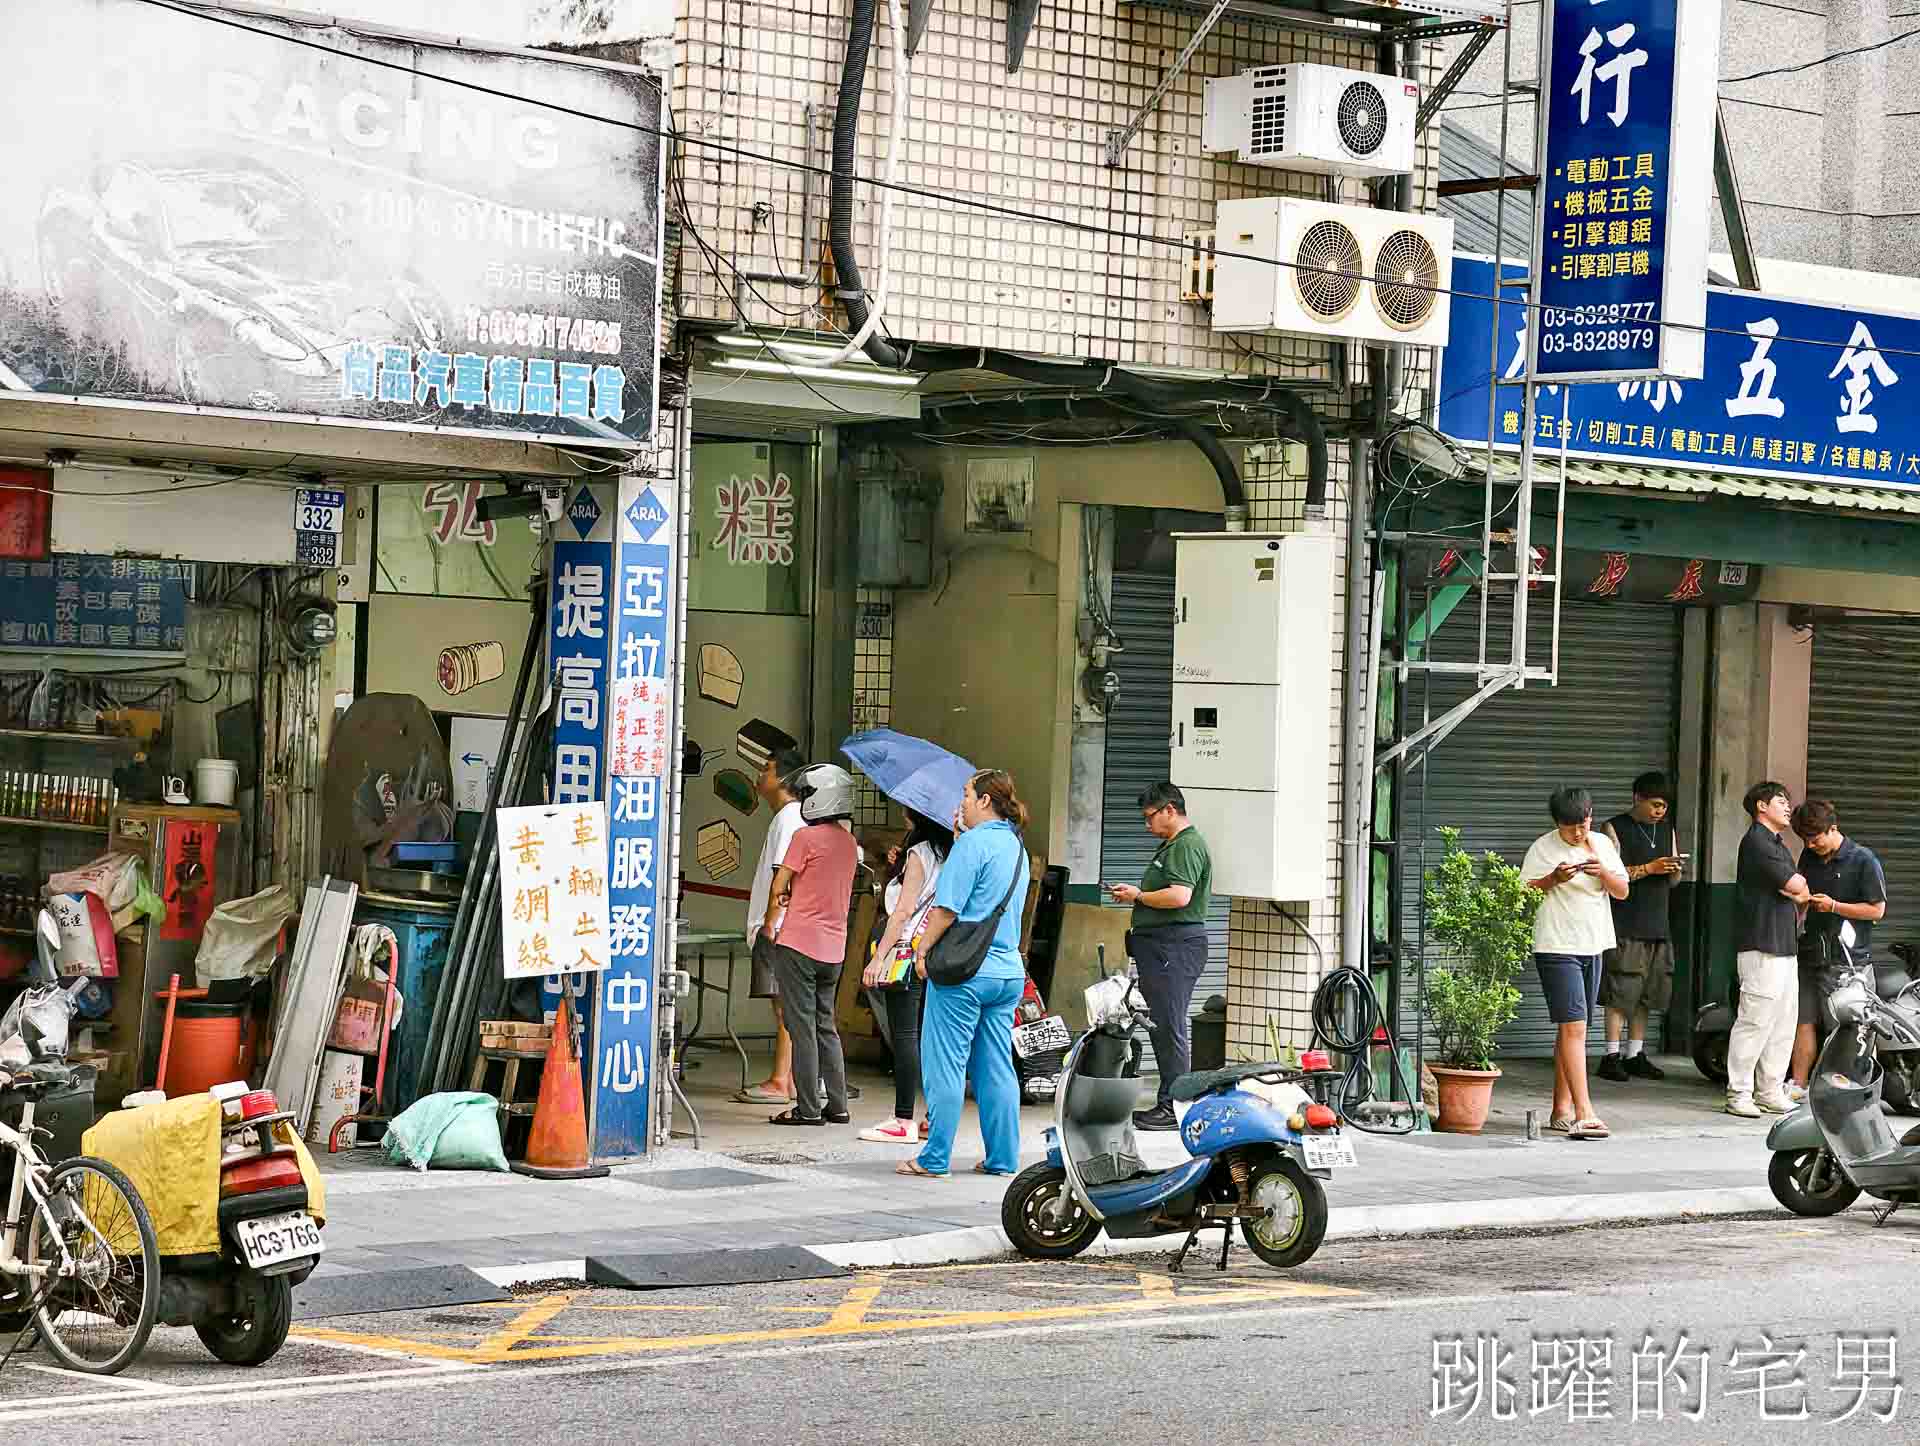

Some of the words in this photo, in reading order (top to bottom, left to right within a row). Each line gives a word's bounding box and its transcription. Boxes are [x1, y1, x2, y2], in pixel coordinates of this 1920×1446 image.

[1570, 0, 1648, 128] 行
[214, 71, 561, 170] RACING
[1567, 153, 1654, 184] 電動工具
[1565, 185, 1653, 216] 機械五金
[450, 200, 626, 257] SYNTHETIC
[1563, 218, 1652, 248] 引擎鏈鋸
[485, 259, 621, 300] 百分百合成機油
[1562, 250, 1649, 280] 引擎割草機
[1544, 302, 1655, 327] 03-8328777
[1543, 328, 1654, 353] 03-8328979
[342, 342, 626, 424] 尚品汽車精品百貨
[303, 507, 333, 530] 332
[422, 481, 497, 546] 弘
[708, 471, 796, 567] 糕
[571, 502, 597, 519] ARAL
[629, 505, 664, 522] ARAL
[311, 546, 334, 565] 332
[602, 564, 664, 1093] 亞拉油服務中心
[510, 825, 554, 969] 黃網線
[567, 812, 603, 967] 車輛出入
[244, 1223, 320, 1260] HCS-766
